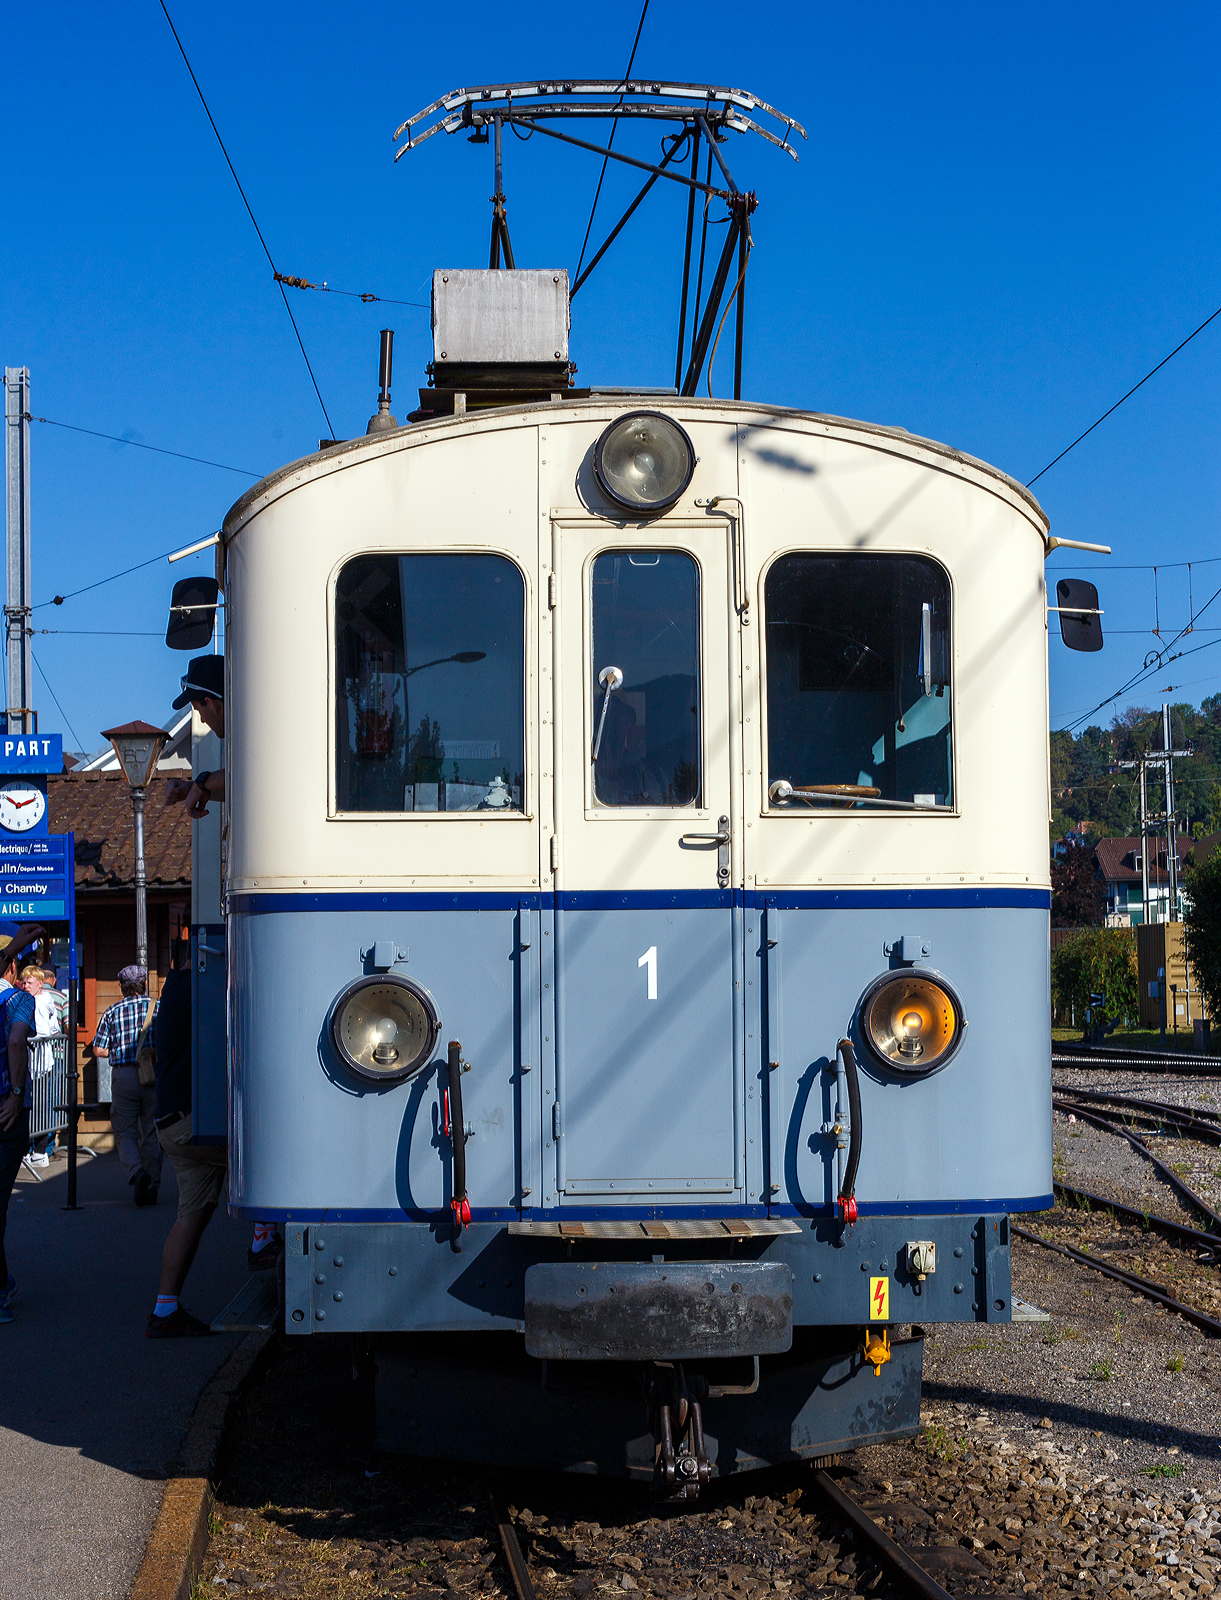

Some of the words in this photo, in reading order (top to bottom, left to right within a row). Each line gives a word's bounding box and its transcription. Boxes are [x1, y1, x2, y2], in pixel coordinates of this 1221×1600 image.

[5, 883, 47, 894] Chamby
[1, 903, 35, 914] AIGLE
[638, 946, 658, 1000] 1
